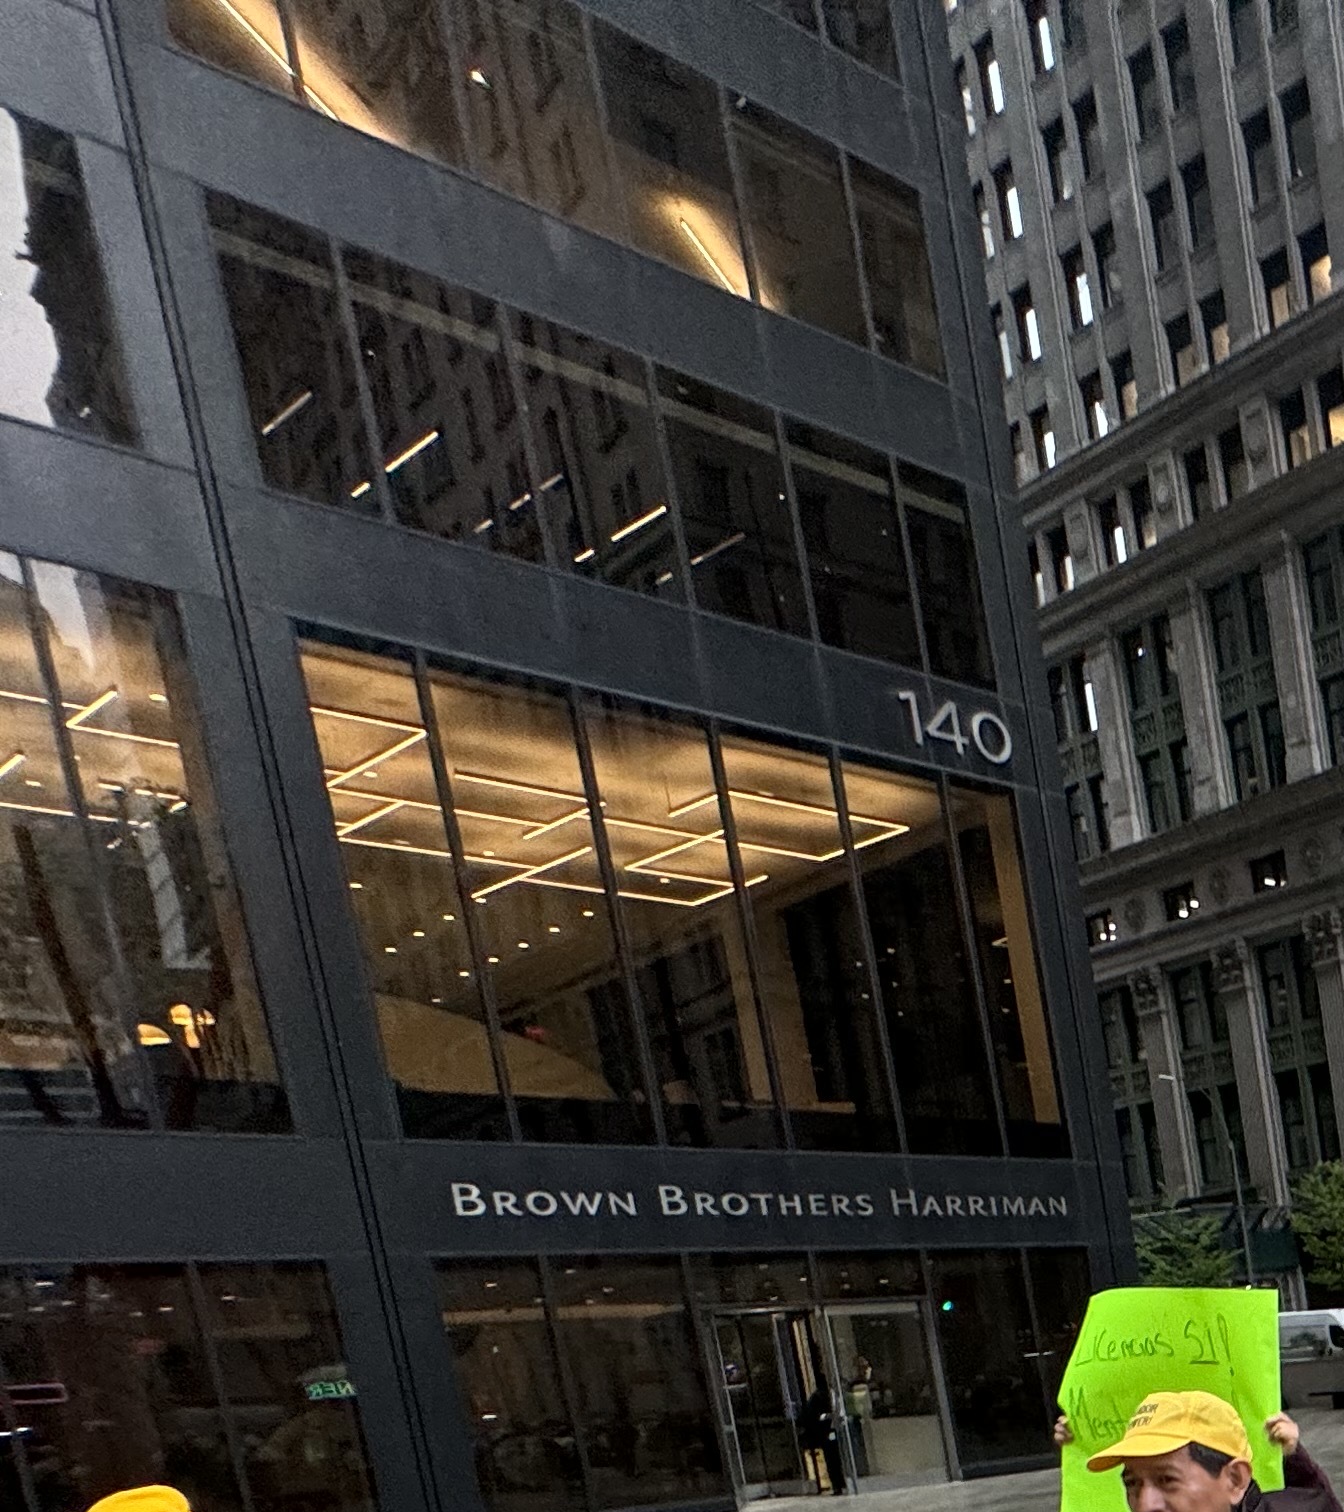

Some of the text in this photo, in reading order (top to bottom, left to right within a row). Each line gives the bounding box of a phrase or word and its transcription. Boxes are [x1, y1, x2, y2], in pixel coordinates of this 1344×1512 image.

[898, 690, 1012, 765] 140
[451, 1182, 1068, 1217] BROWN BROTHERS HARRIMAN
